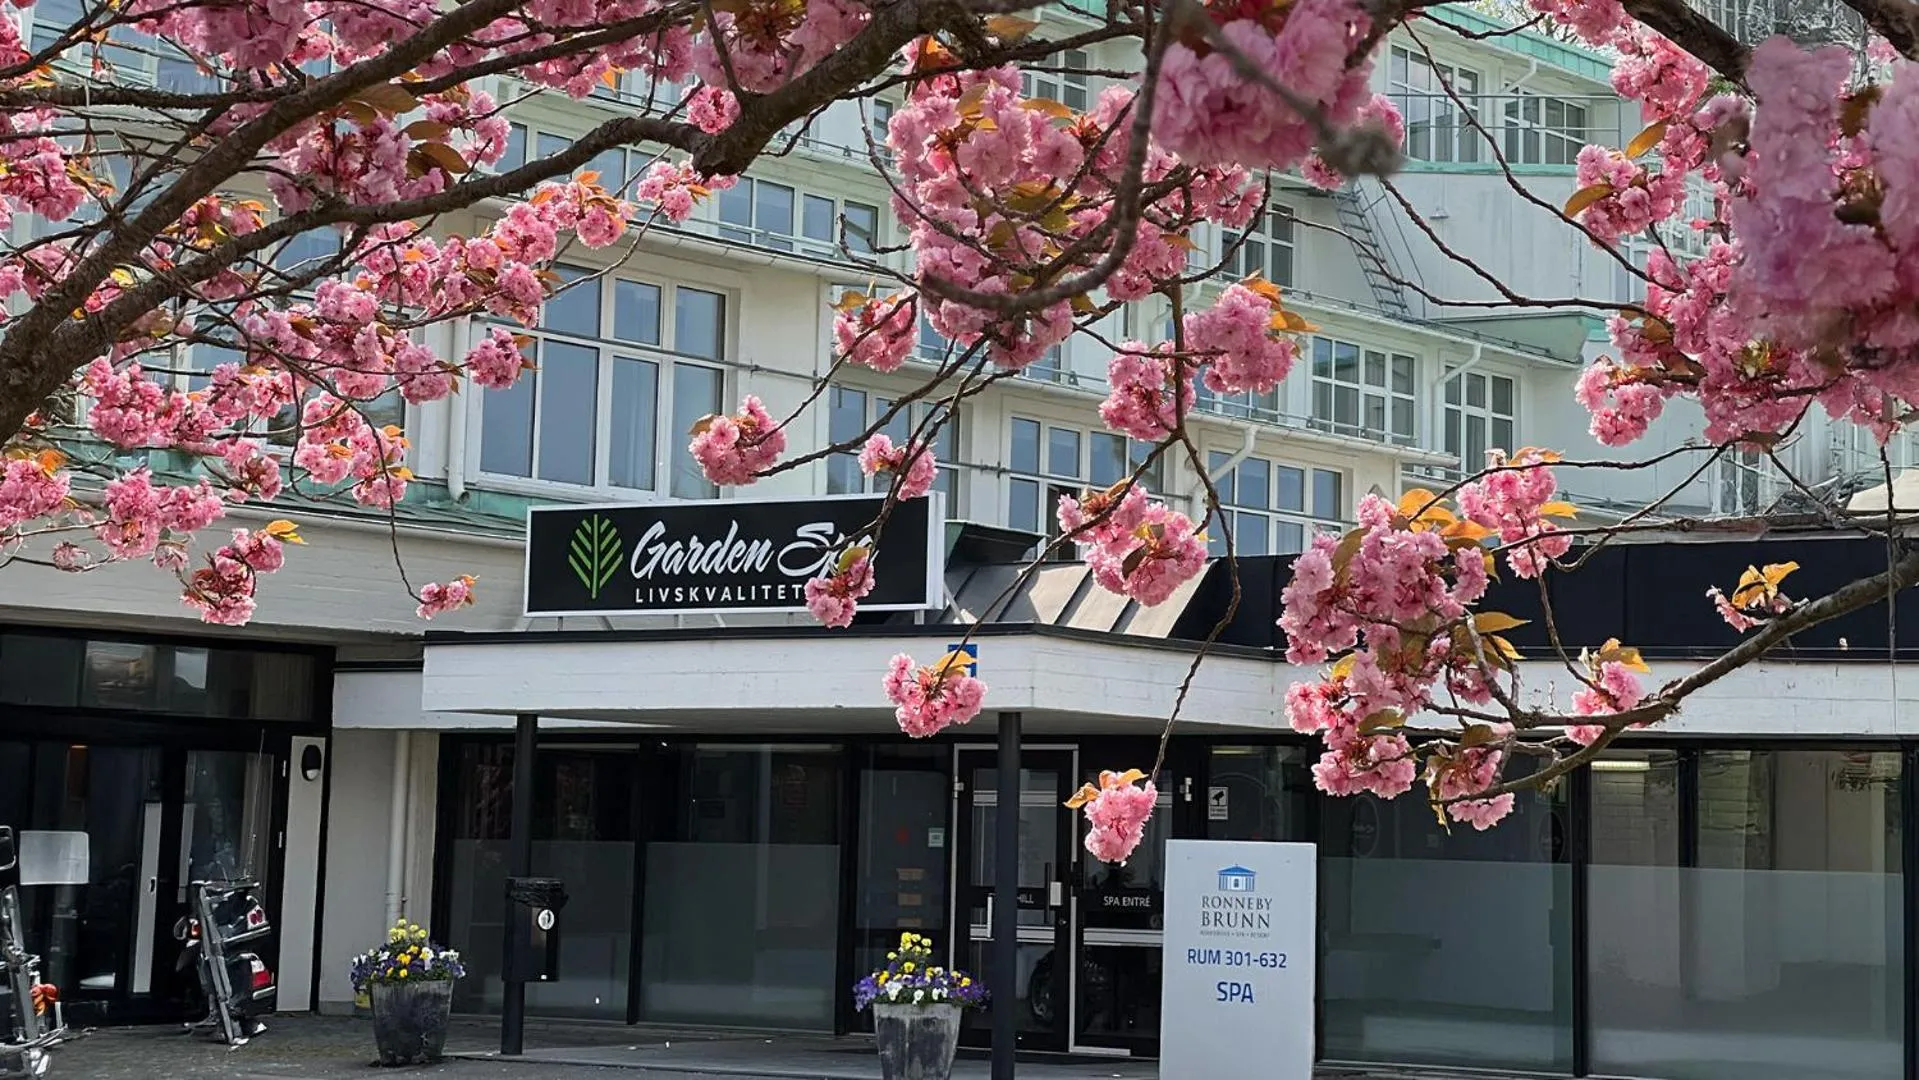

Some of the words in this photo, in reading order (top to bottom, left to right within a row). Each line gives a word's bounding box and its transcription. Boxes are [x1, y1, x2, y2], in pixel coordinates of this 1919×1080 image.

[631, 519, 775, 579] Garden
[635, 584, 803, 603] LIVSKVALITET
[1103, 895, 1120, 907] SPA
[1201, 895, 1273, 910] RONNEBY
[1202, 911, 1270, 928] BRUNN
[1187, 948, 1221, 965] RUM
[1225, 951, 1287, 968] 301-632
[1216, 981, 1254, 1003] SPA
